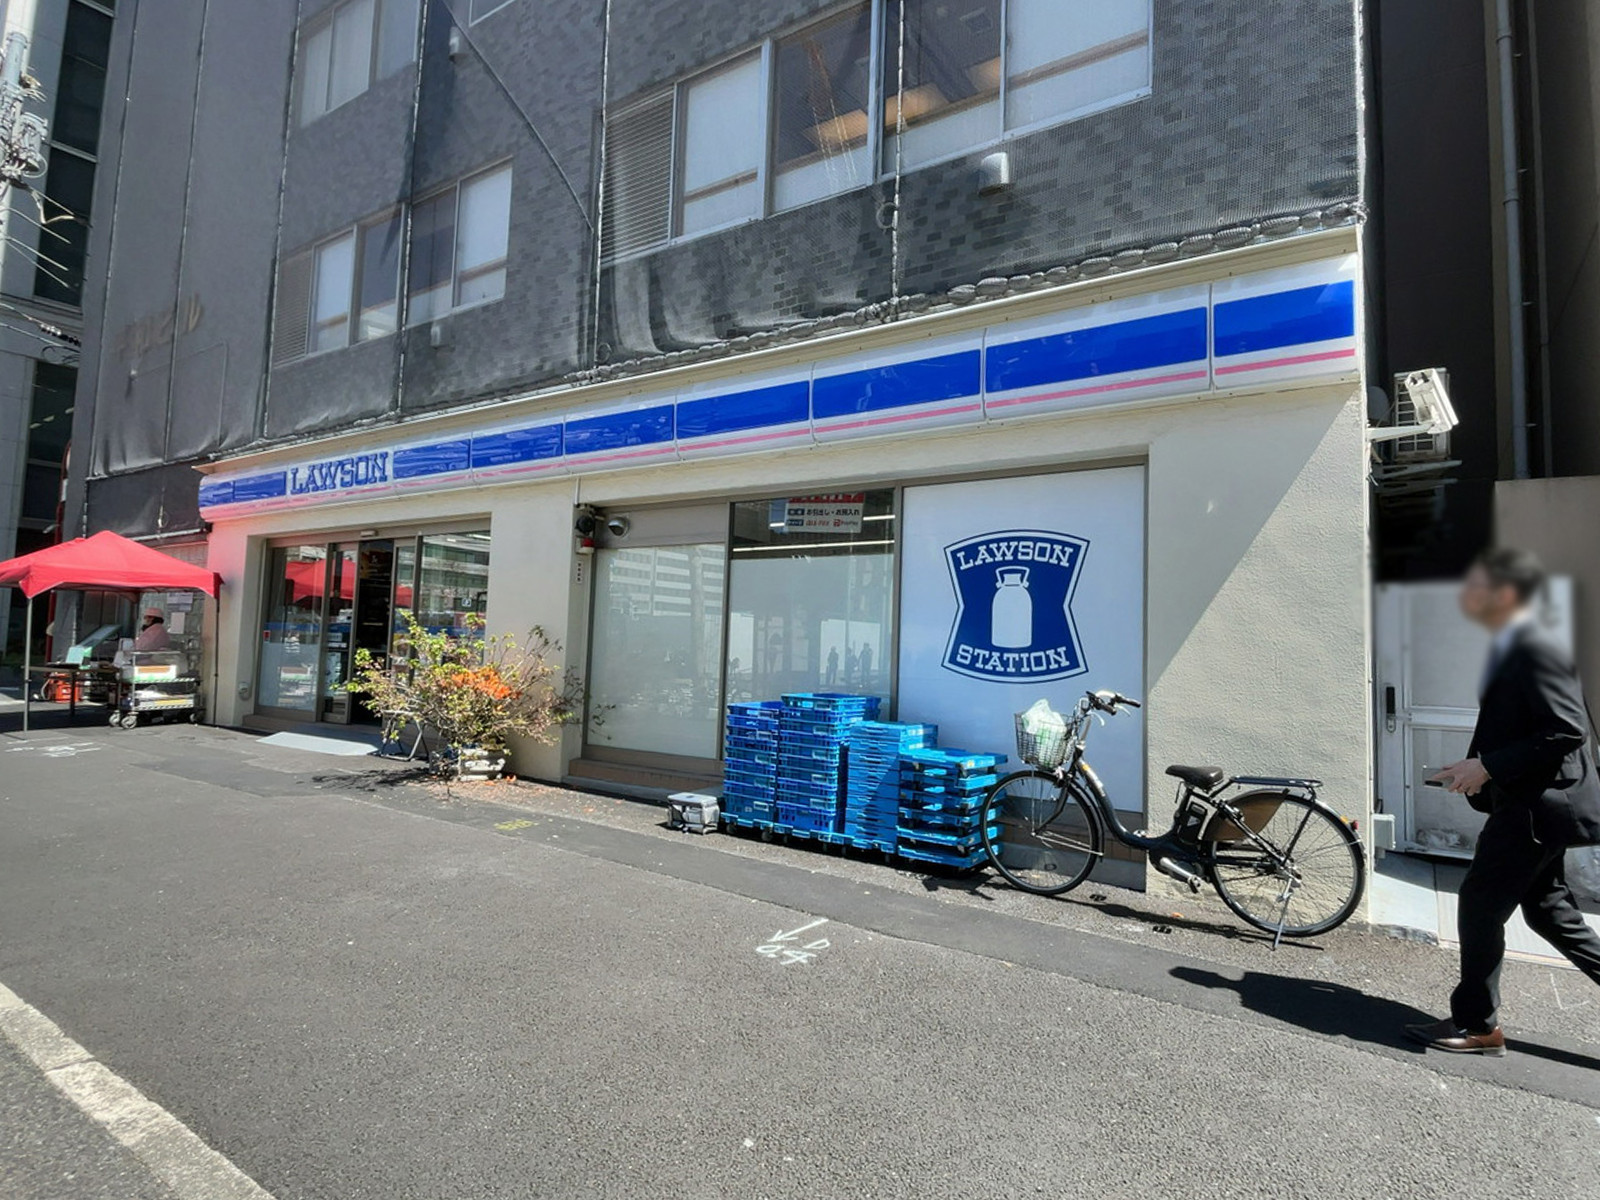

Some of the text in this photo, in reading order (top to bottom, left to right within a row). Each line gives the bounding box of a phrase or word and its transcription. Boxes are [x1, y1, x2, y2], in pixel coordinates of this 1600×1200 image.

[290, 451, 389, 494] LAWSON
[956, 541, 1074, 571] LAWSON
[956, 643, 1071, 673] STATION
